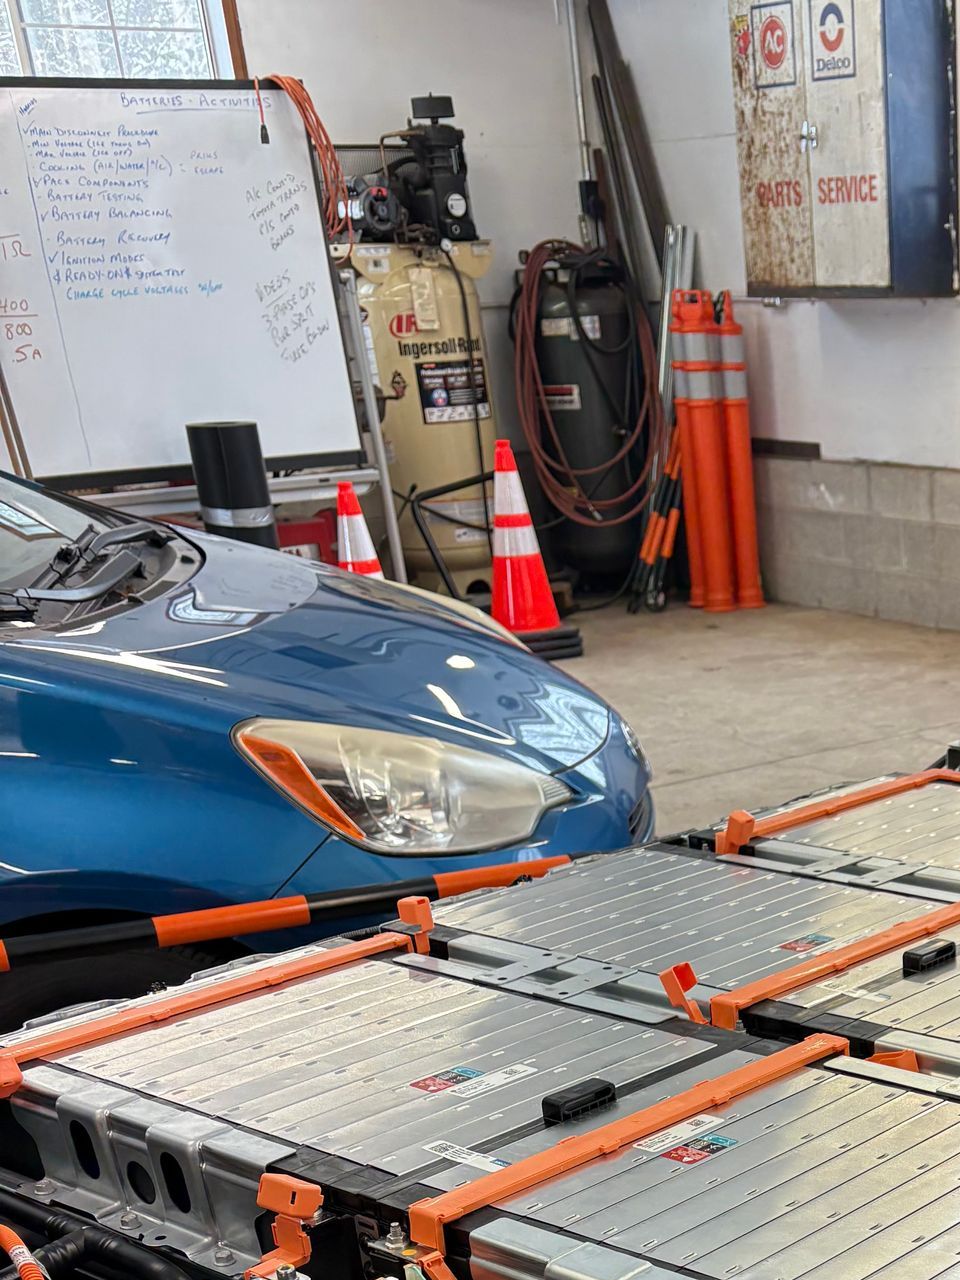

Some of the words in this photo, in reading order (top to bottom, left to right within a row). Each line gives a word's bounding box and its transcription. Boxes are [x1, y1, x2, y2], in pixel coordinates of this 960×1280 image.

[765, 29, 783, 54] AC
[816, 57, 850, 72] Delco
[757, 179, 802, 208] PARTS
[817, 174, 878, 205] SERVICE
[52, 206, 100, 222] BATTERY
[109, 207, 172, 219] BALANCING
[57, 230, 106, 247] BATTERY
[5, 323, 32, 340] 800
